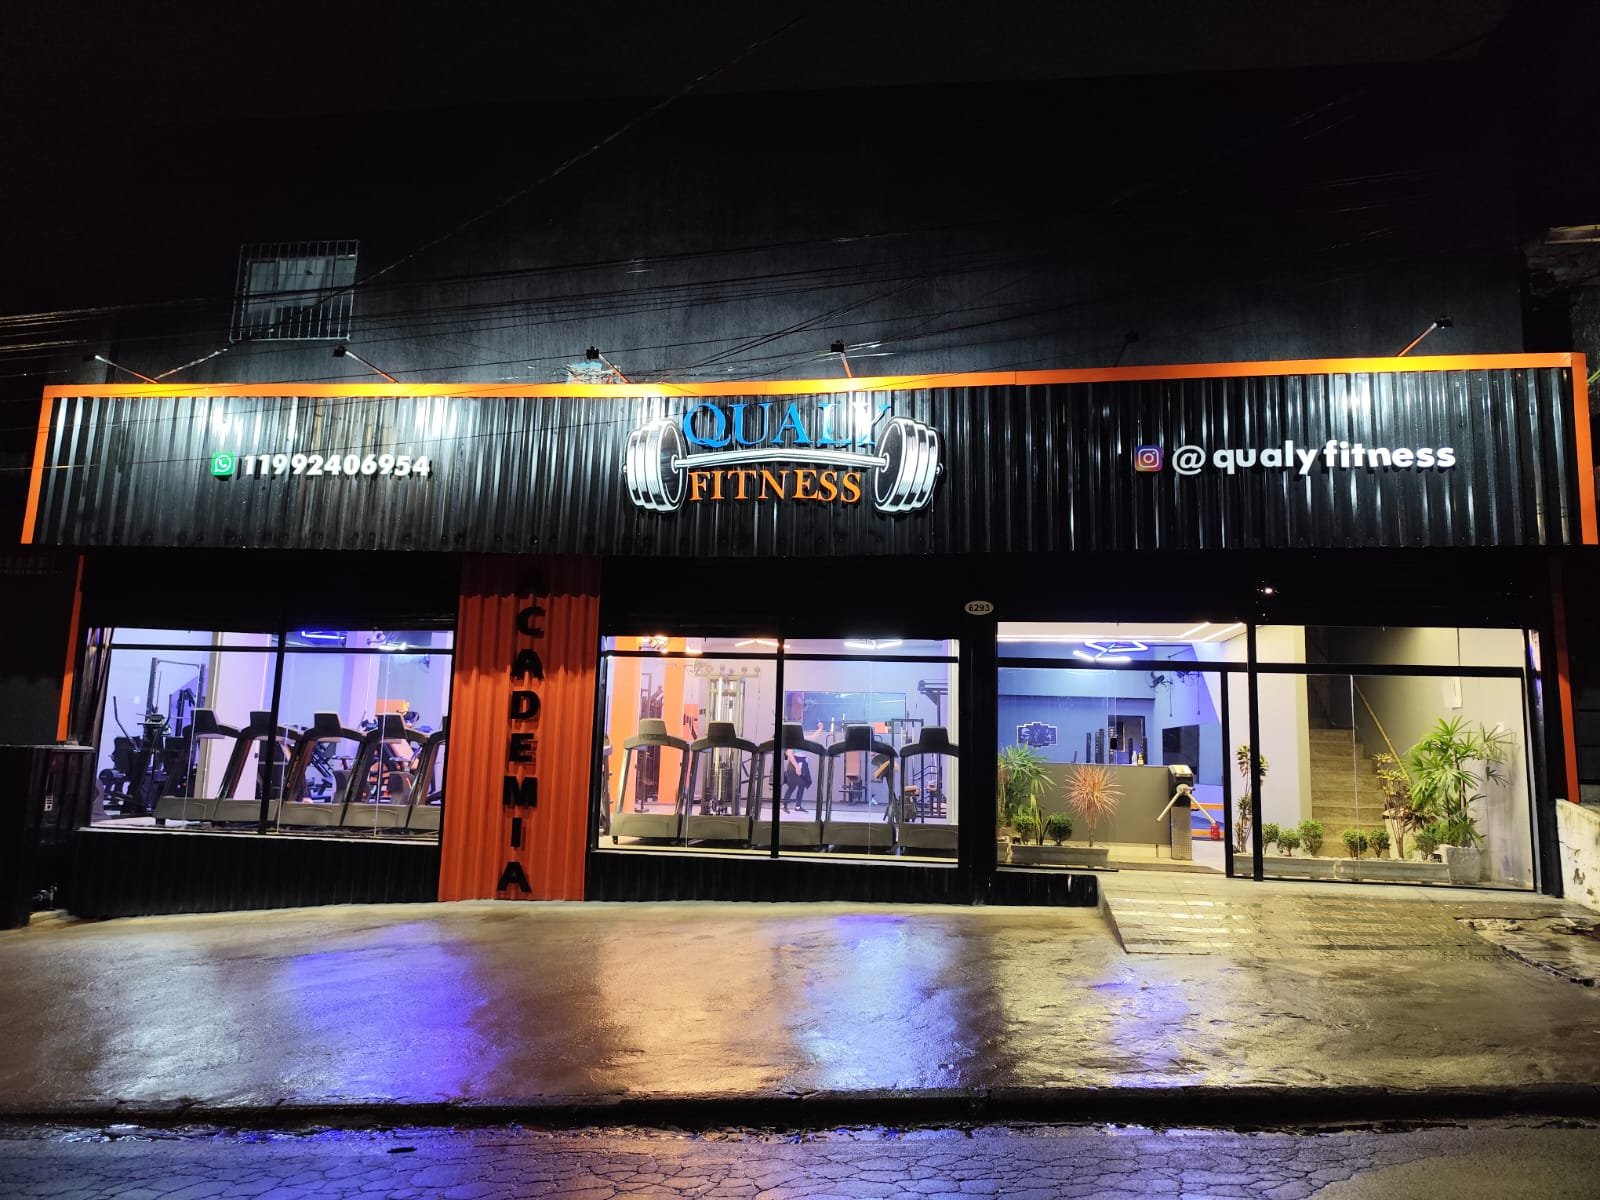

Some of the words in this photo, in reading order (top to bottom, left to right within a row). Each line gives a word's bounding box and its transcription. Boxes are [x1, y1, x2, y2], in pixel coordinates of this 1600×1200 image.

[683, 401, 892, 448] QUALY
[244, 453, 430, 476] 11992406954
[688, 469, 861, 502] FITNESS
[968, 603, 990, 611] 6293
